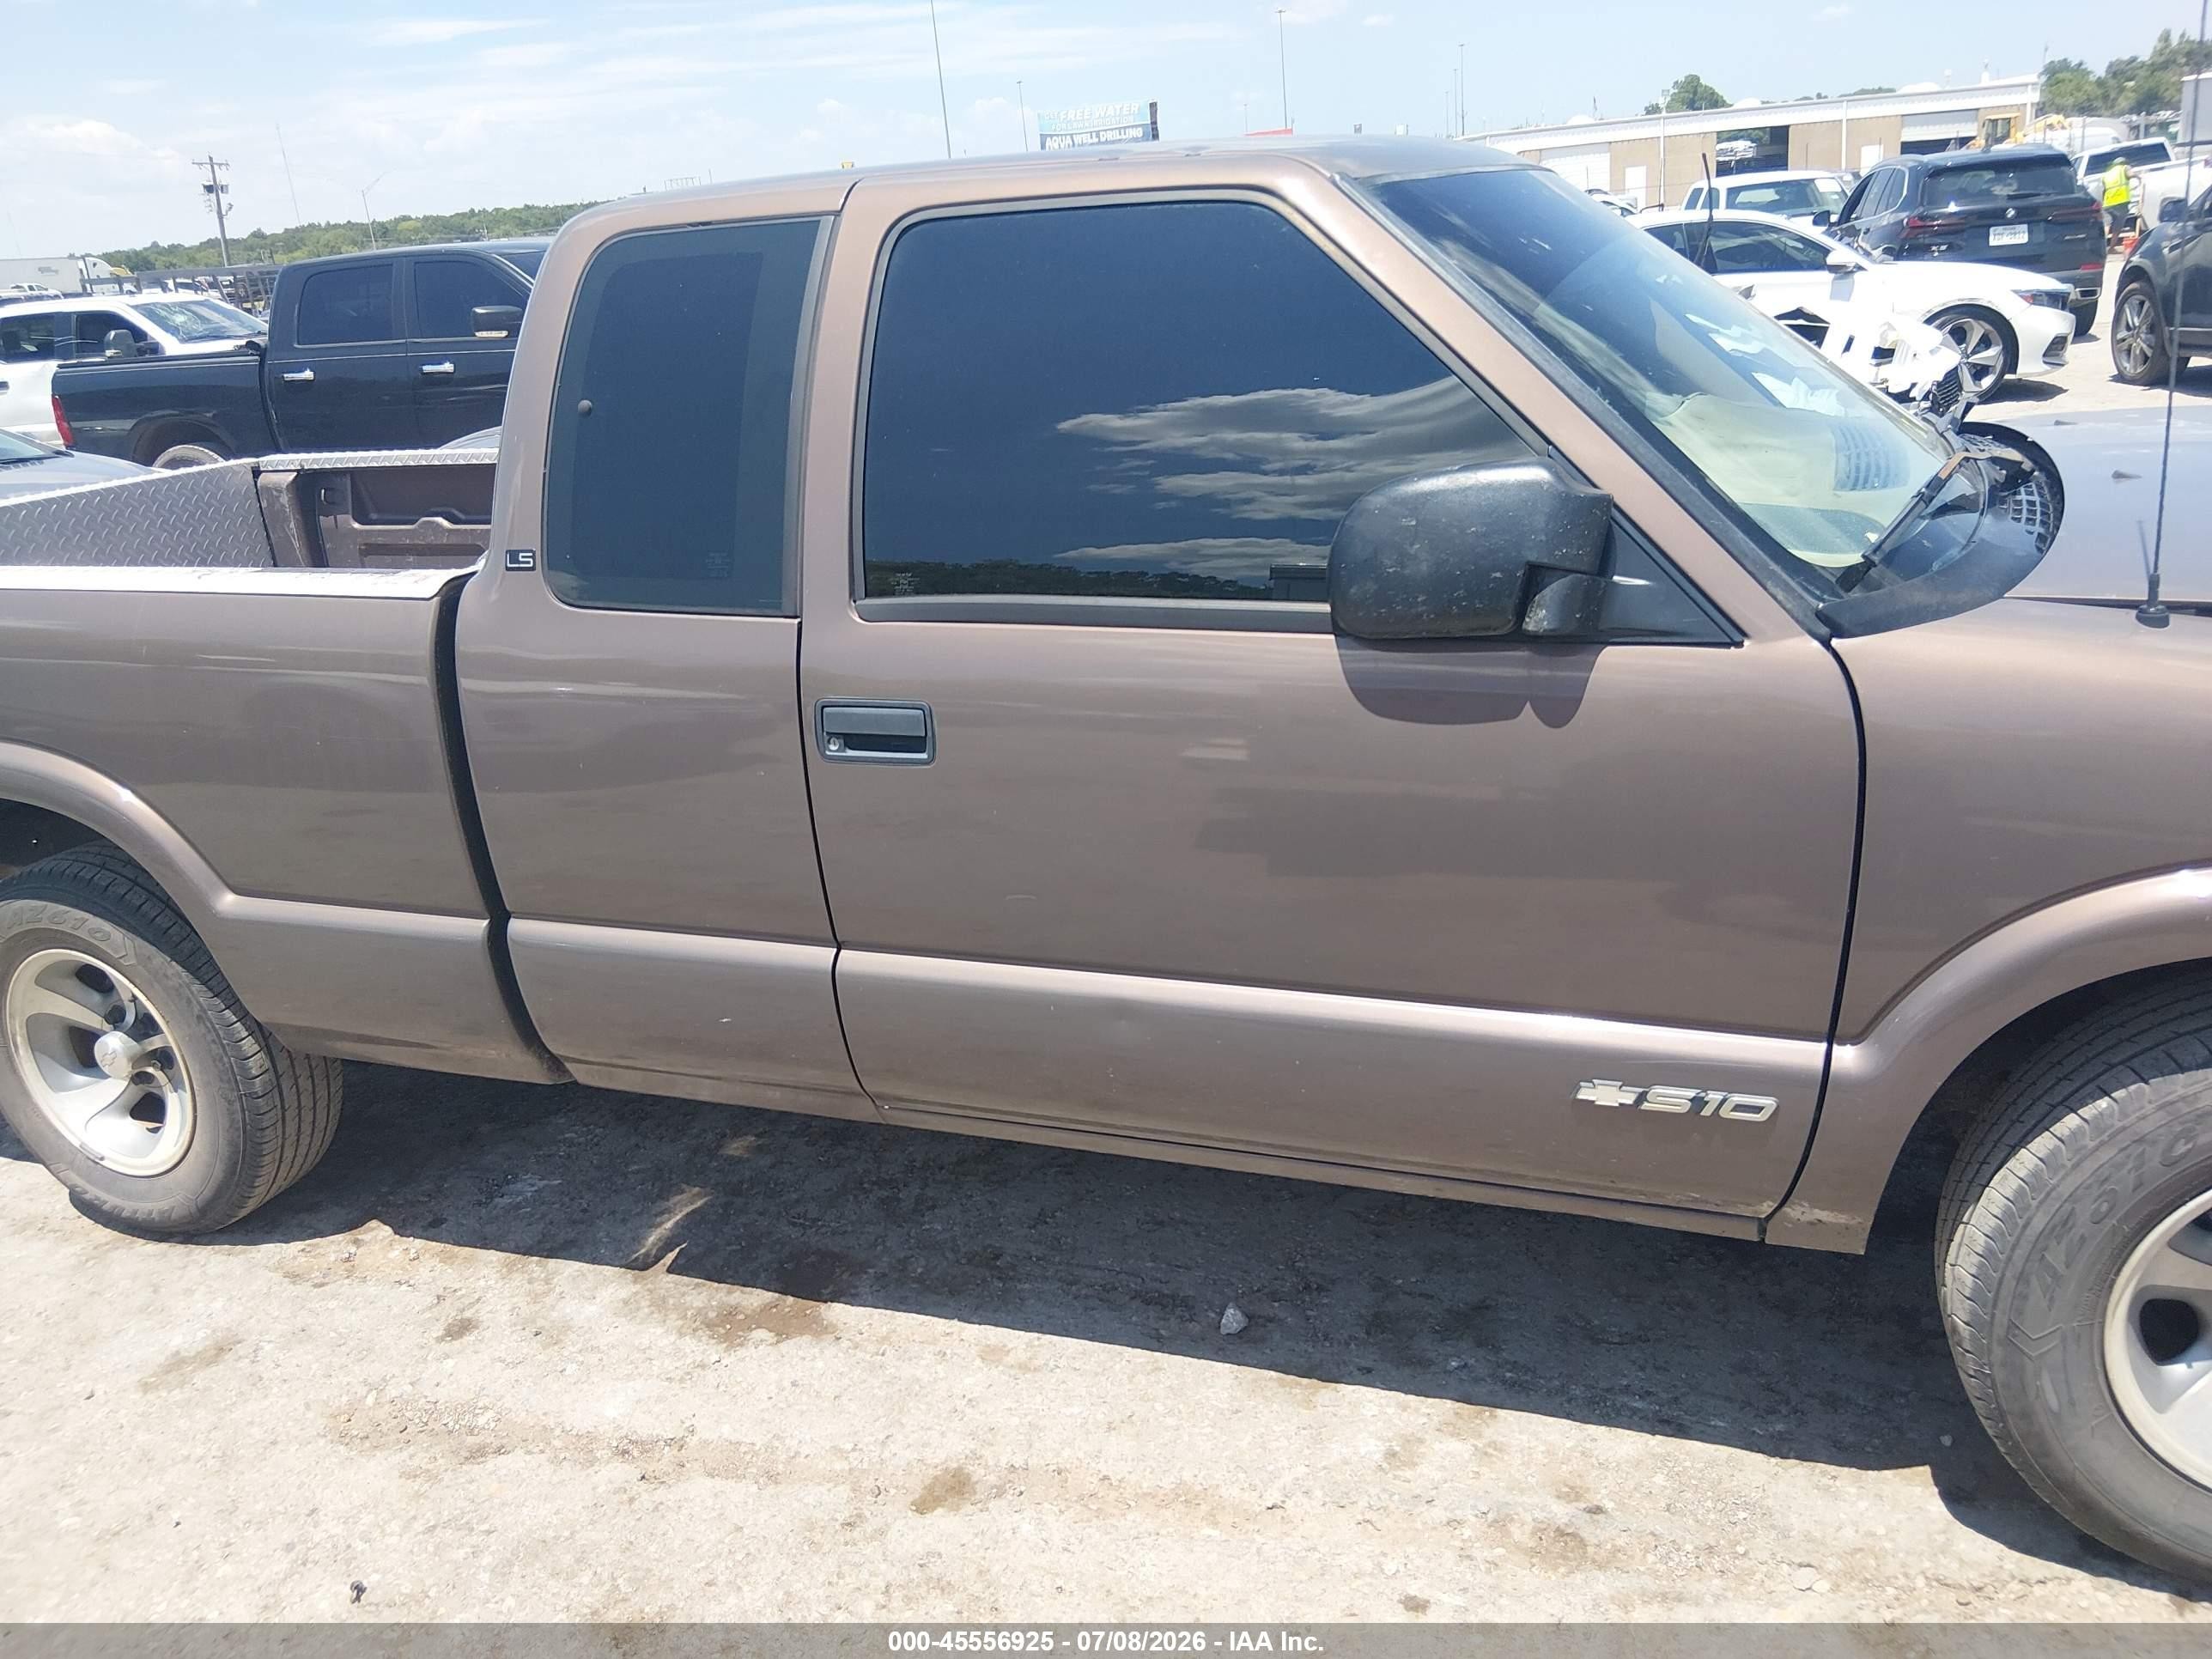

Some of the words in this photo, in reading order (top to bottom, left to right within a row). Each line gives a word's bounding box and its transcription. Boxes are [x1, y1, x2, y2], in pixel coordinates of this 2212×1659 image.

[1044, 111, 1058, 119] GET
[1058, 109, 1092, 121] FREE
[1095, 103, 1140, 118] WATER
[1052, 123, 1066, 131] FOR
[1045, 136, 1073, 151] AQUA
[1073, 131, 1098, 144] WELL
[1100, 128, 1143, 142] DRILLING
[507, 552, 532, 567] LS
[1640, 1085, 1779, 1121] S10
